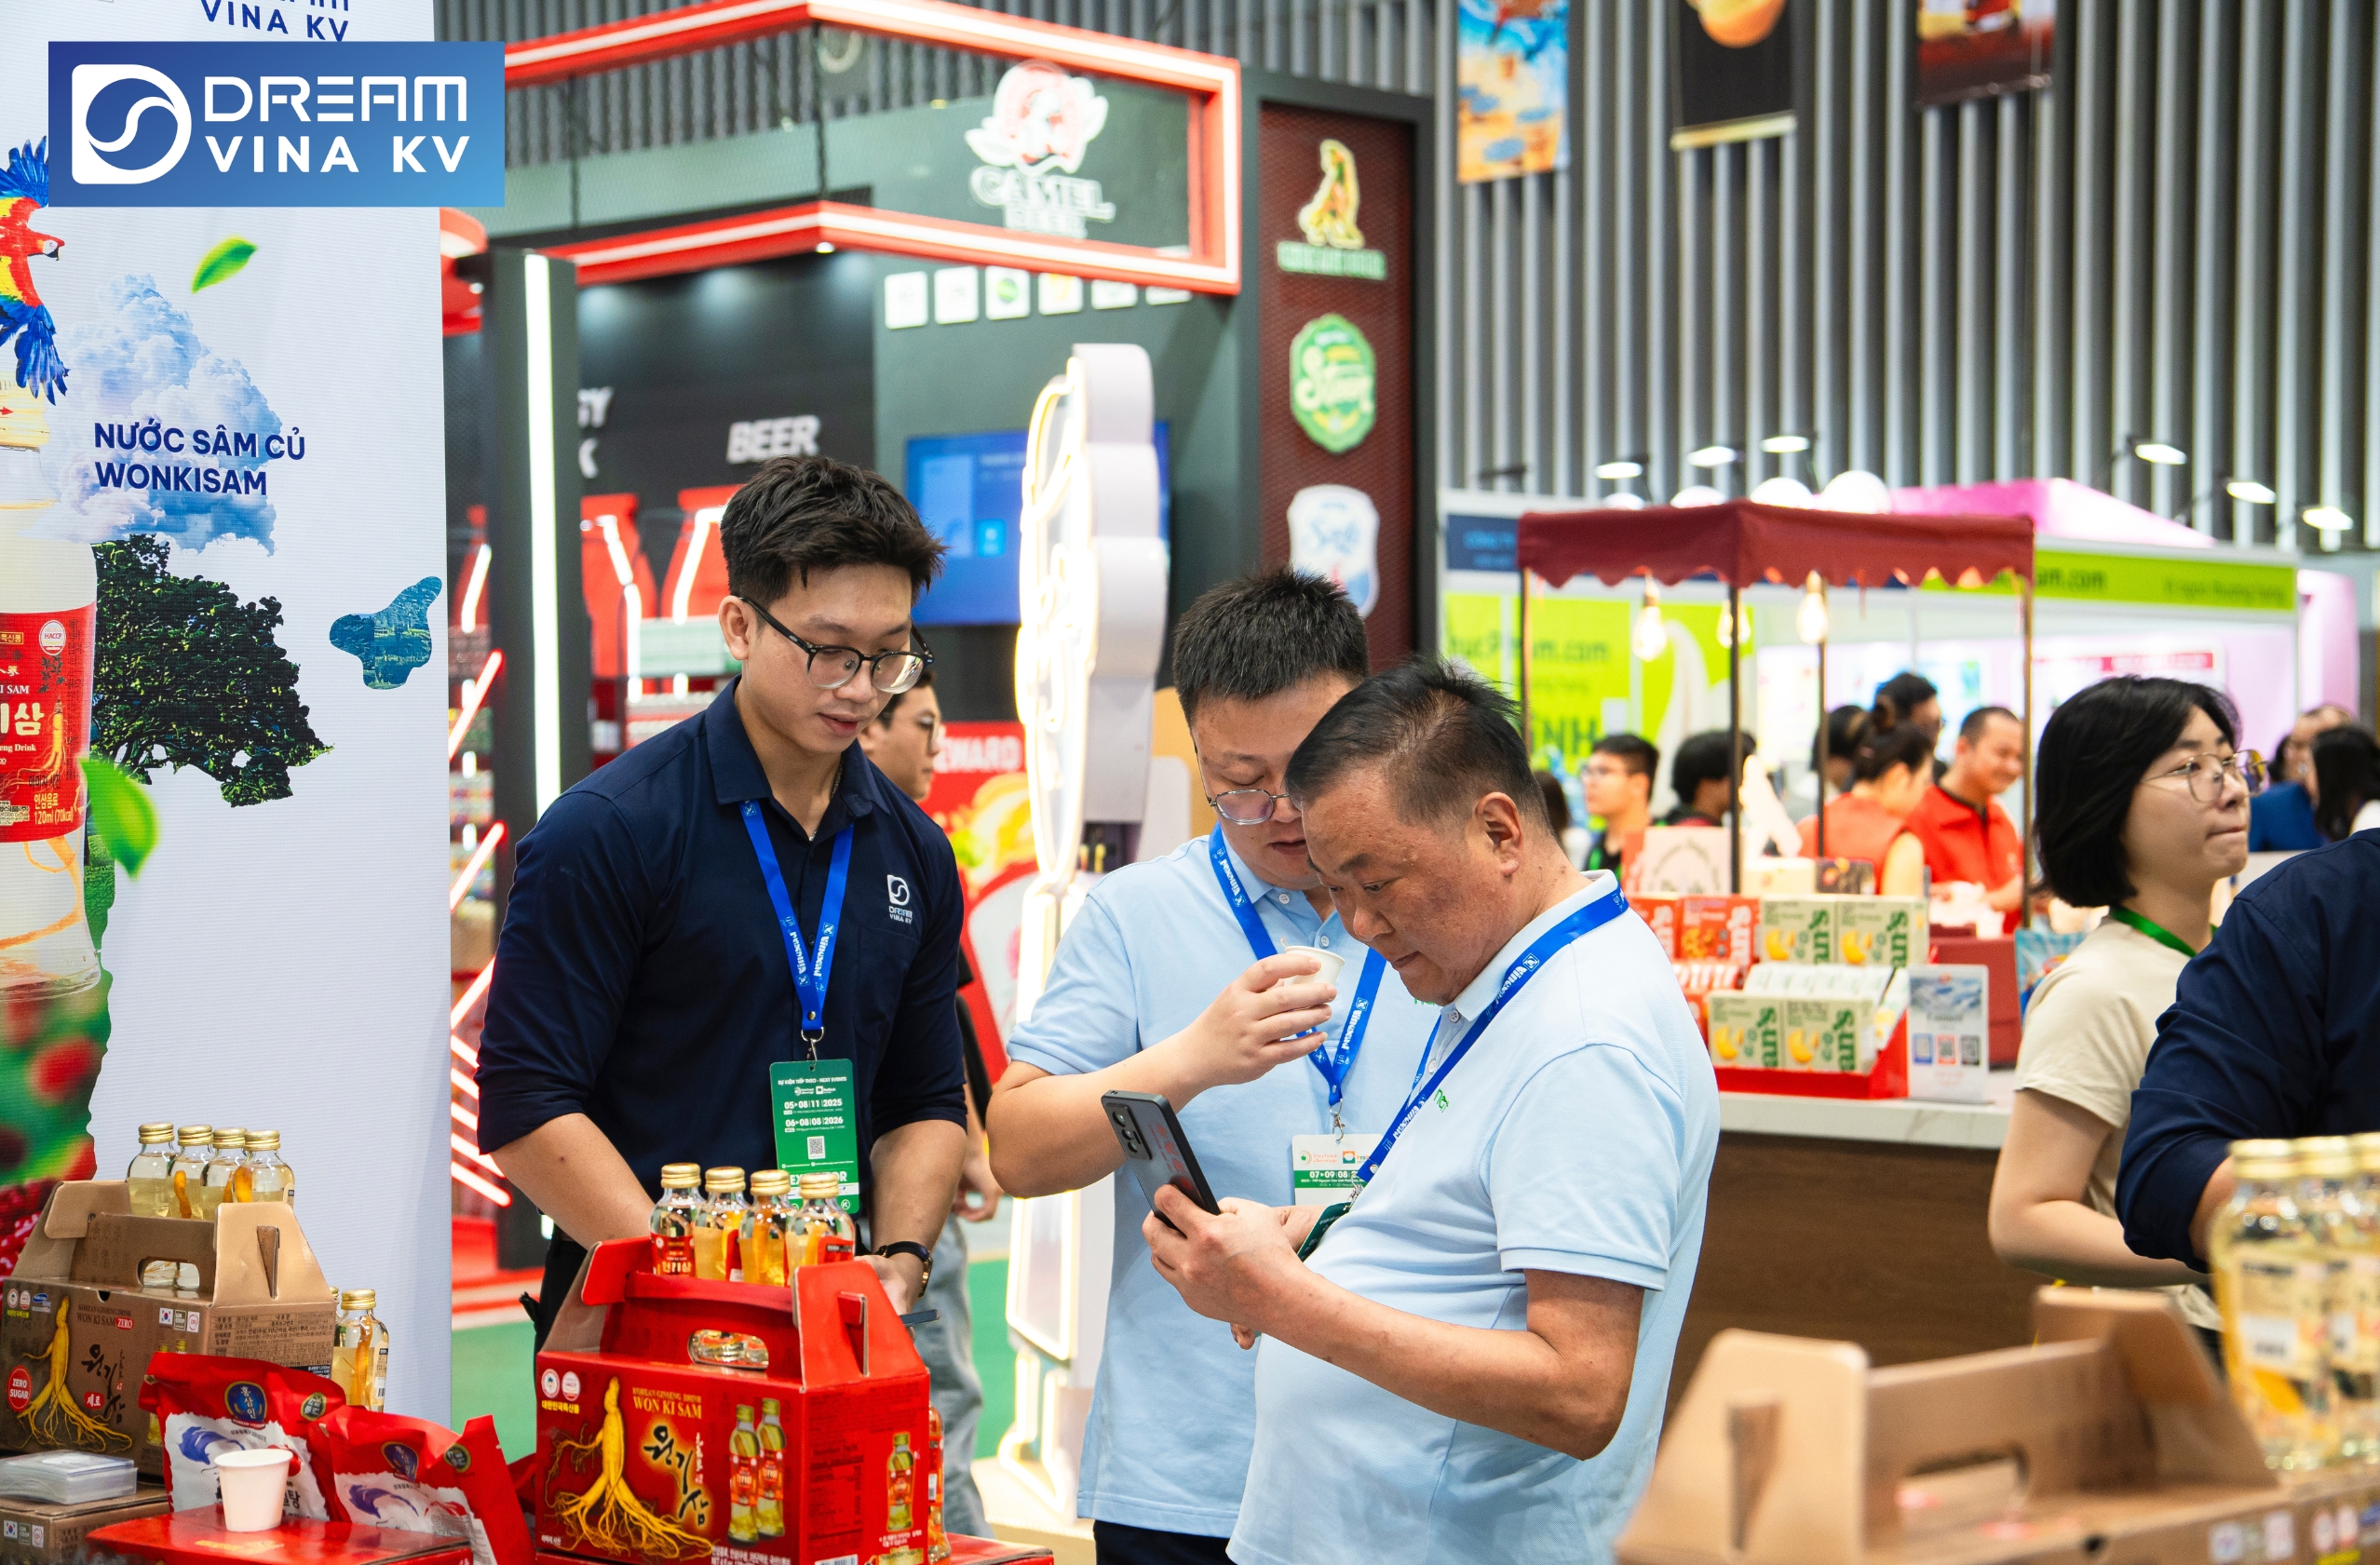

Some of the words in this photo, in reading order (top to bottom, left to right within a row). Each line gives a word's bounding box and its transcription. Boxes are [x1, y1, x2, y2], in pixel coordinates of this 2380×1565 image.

[201, 0, 289, 34] VINA
[306, 16, 349, 42] KV
[94, 418, 184, 452] NƯỚC
[193, 424, 259, 458] SÂM
[264, 426, 305, 461] CỦ
[726, 414, 821, 465] BEER
[95, 461, 267, 496] WONKISAM
[7, 684, 30, 695] SAM
[34, 792, 59, 810] 인삼음료
[889, 913, 904, 923] VINA
[789, 931, 806, 975] Vinexad
[813, 936, 830, 978] Vinexad
[76, 1312, 92, 1323] WON
[93, 1315, 101, 1325] KI
[101, 1315, 115, 1327] SAM
[117, 1317, 133, 1329] ZERO
[9, 1388, 29, 1400] SUGAR
[12, 1378, 27, 1388] ZERO
[633, 1396, 660, 1413] WON
[663, 1400, 675, 1415] KI
[677, 1402, 702, 1419] SAM
